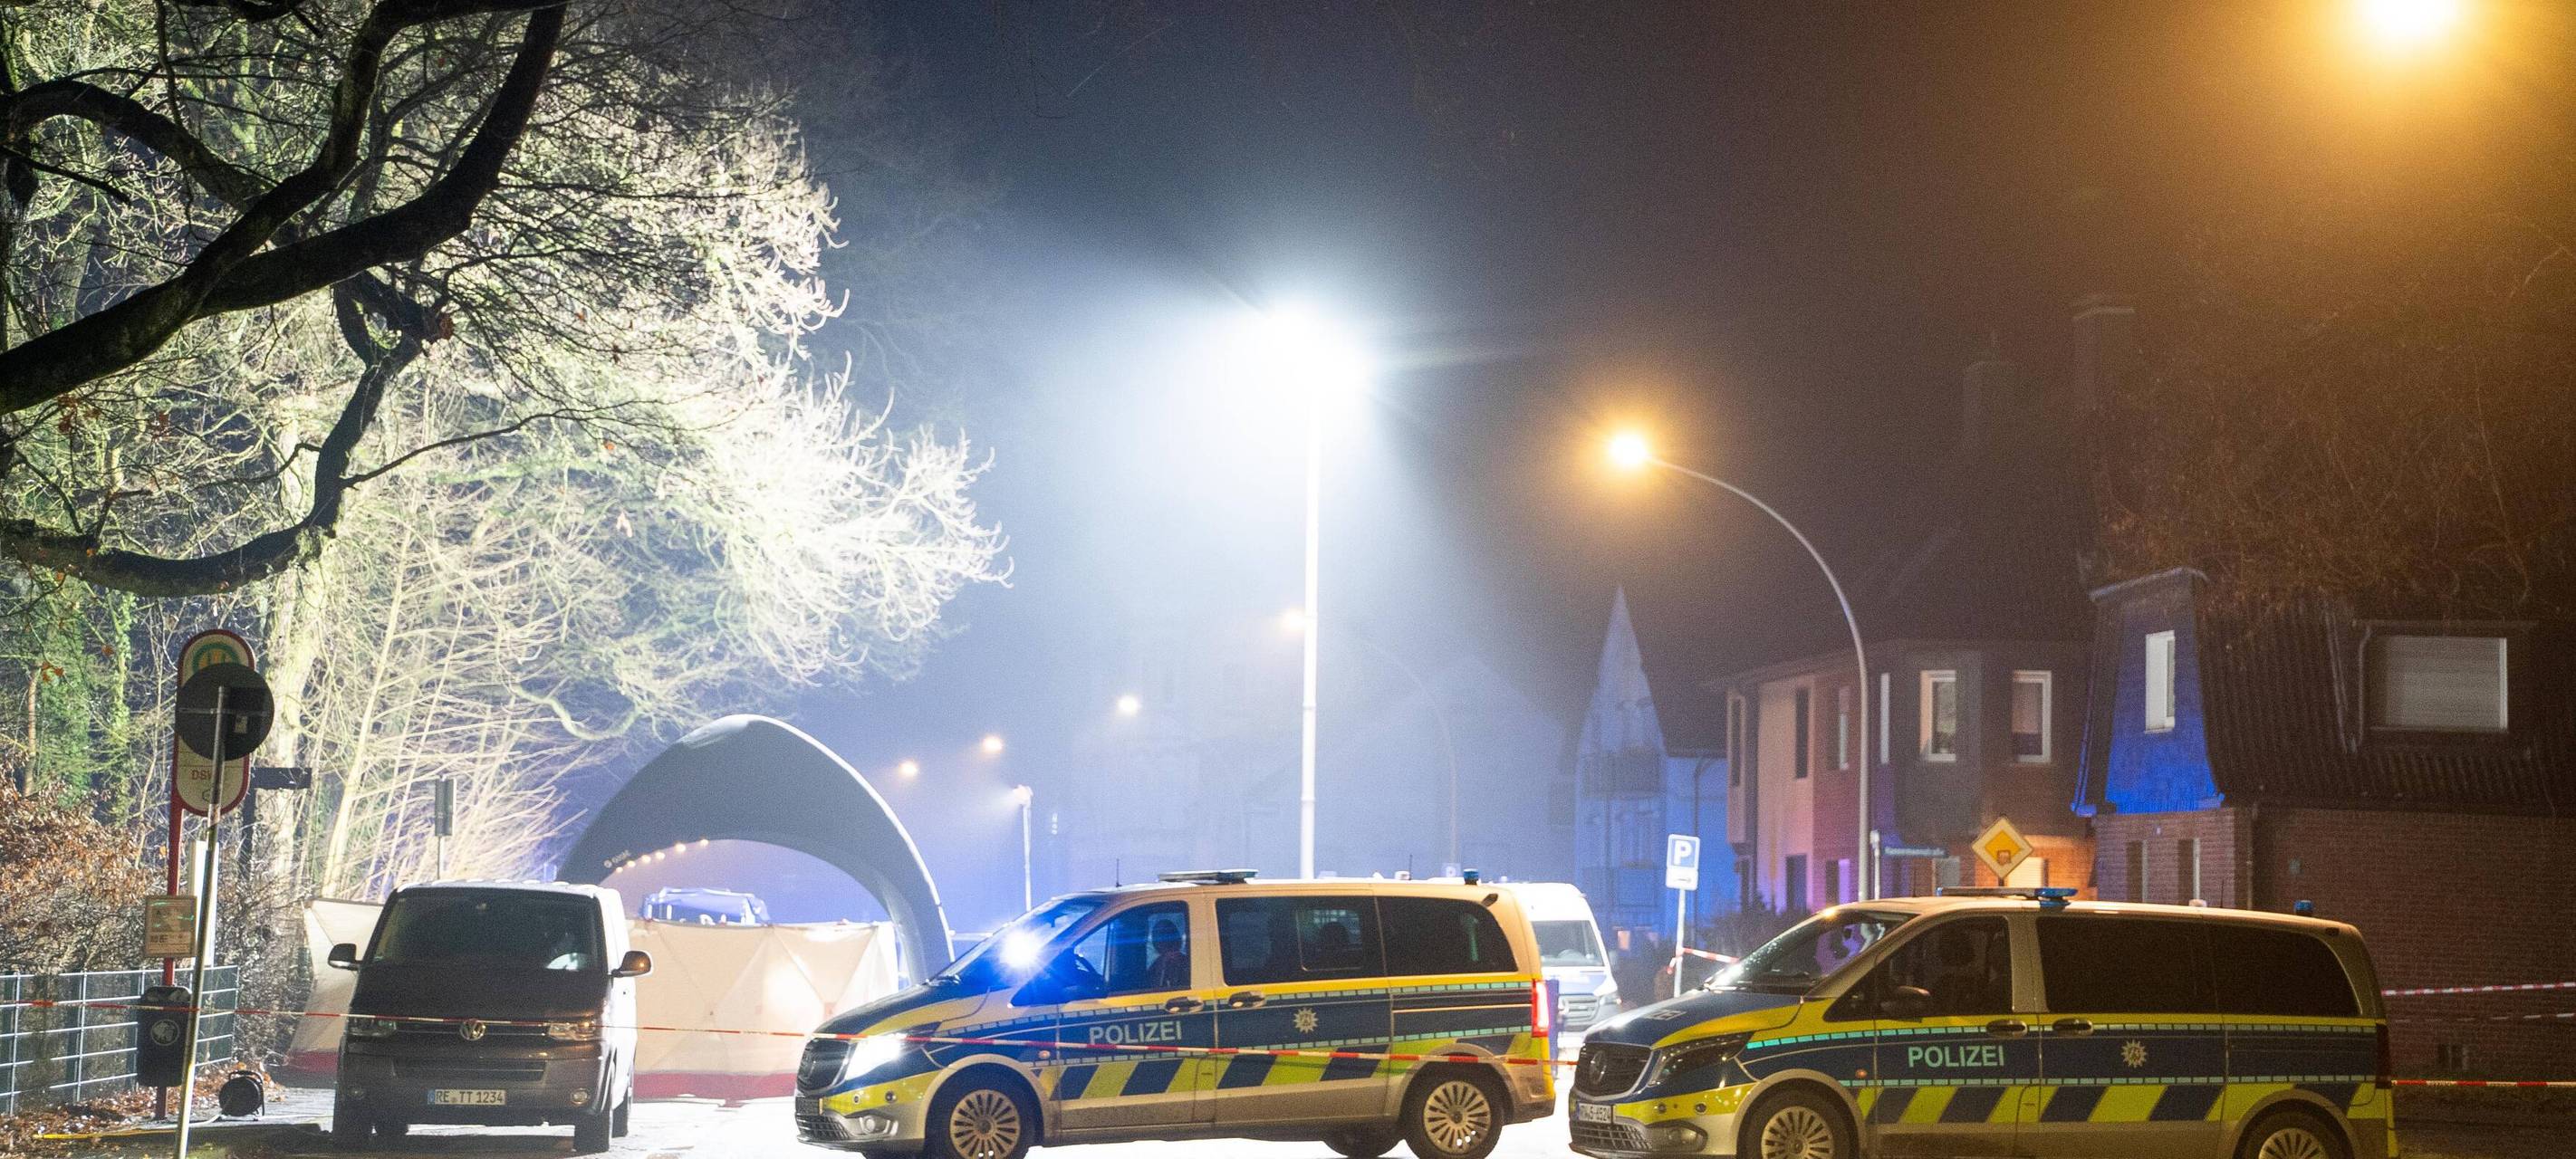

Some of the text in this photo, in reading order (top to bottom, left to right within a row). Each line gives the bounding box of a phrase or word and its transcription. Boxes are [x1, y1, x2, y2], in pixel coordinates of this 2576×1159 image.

[1674, 840, 1692, 865] P
[1090, 1020, 1182, 1044] POLIZEI
[1908, 1045, 2004, 1068] POLIZEI
[436, 1091, 504, 1103] RE TT 1234
